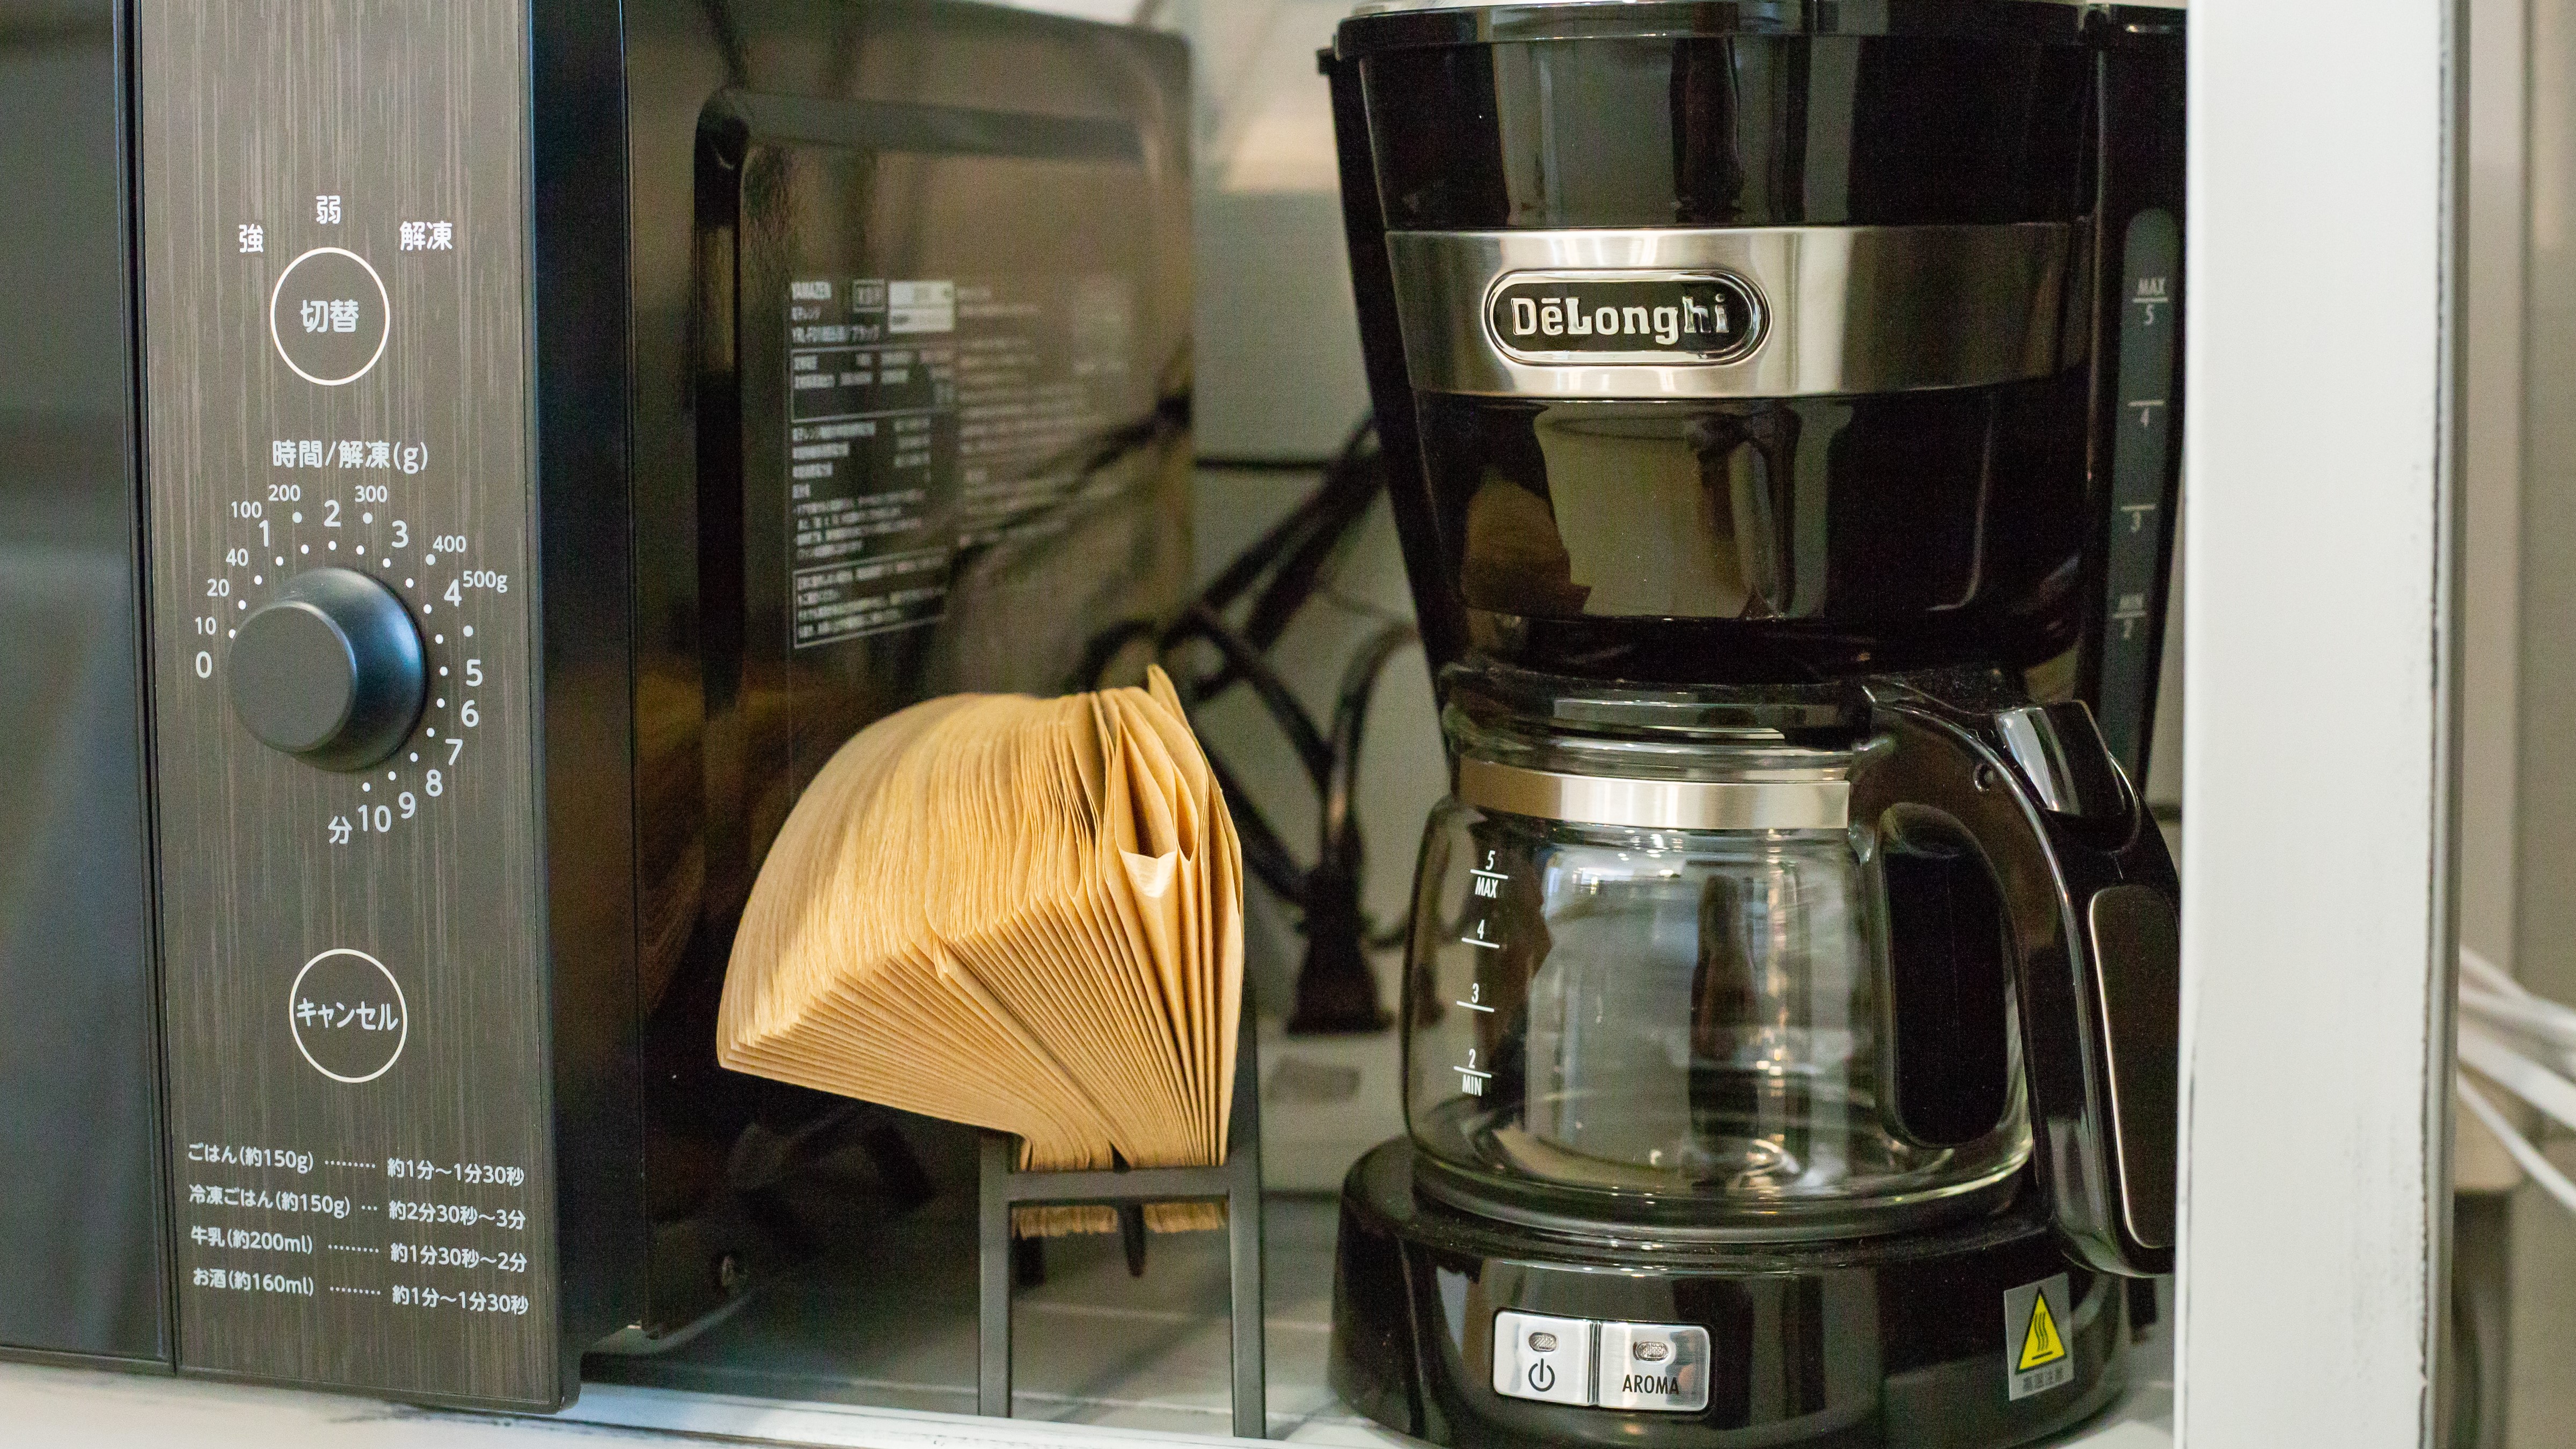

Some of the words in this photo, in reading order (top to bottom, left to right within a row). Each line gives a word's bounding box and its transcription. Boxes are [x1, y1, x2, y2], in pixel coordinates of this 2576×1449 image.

[316, 195, 341, 224] 弱
[239, 224, 264, 253] 強
[400, 221, 452, 251] 解凍
[2138, 277, 2165, 295] MAX
[301, 299, 358, 333] 切替
[2143, 304, 2154, 325] 5
[272, 440, 428, 474] 時間/解凍(g)
[268, 484, 301, 501] 200
[355, 485, 387, 502] 300
[231, 501, 262, 518] 100
[324, 500, 341, 527] 2
[259, 519, 269, 547] 1
[391, 520, 409, 548] 3
[433, 535, 466, 552] 400
[225, 548, 248, 566] 40
[207, 579, 230, 597] 20
[444, 579, 462, 607] 4
[463, 570, 508, 593] 500g
[195, 617, 217, 635] 10
[195, 651, 212, 678] 0
[466, 659, 483, 686] 5
[461, 700, 479, 727] 6
[445, 738, 463, 766] 7
[426, 769, 443, 797] 8
[357, 804, 391, 832] 10
[398, 792, 416, 819] 9
[328, 816, 353, 844] 分
[1485, 850, 1496, 870] 5
[1475, 876, 1498, 898] MAX
[1477, 919, 1484, 939] 4
[1471, 983, 1479, 1003] 3
[296, 997, 399, 1031] キャンセル
[1468, 1048, 1476, 1069] 2
[1462, 1074, 1482, 1096] MIN
[1622, 1374, 1680, 1395] AROMA
